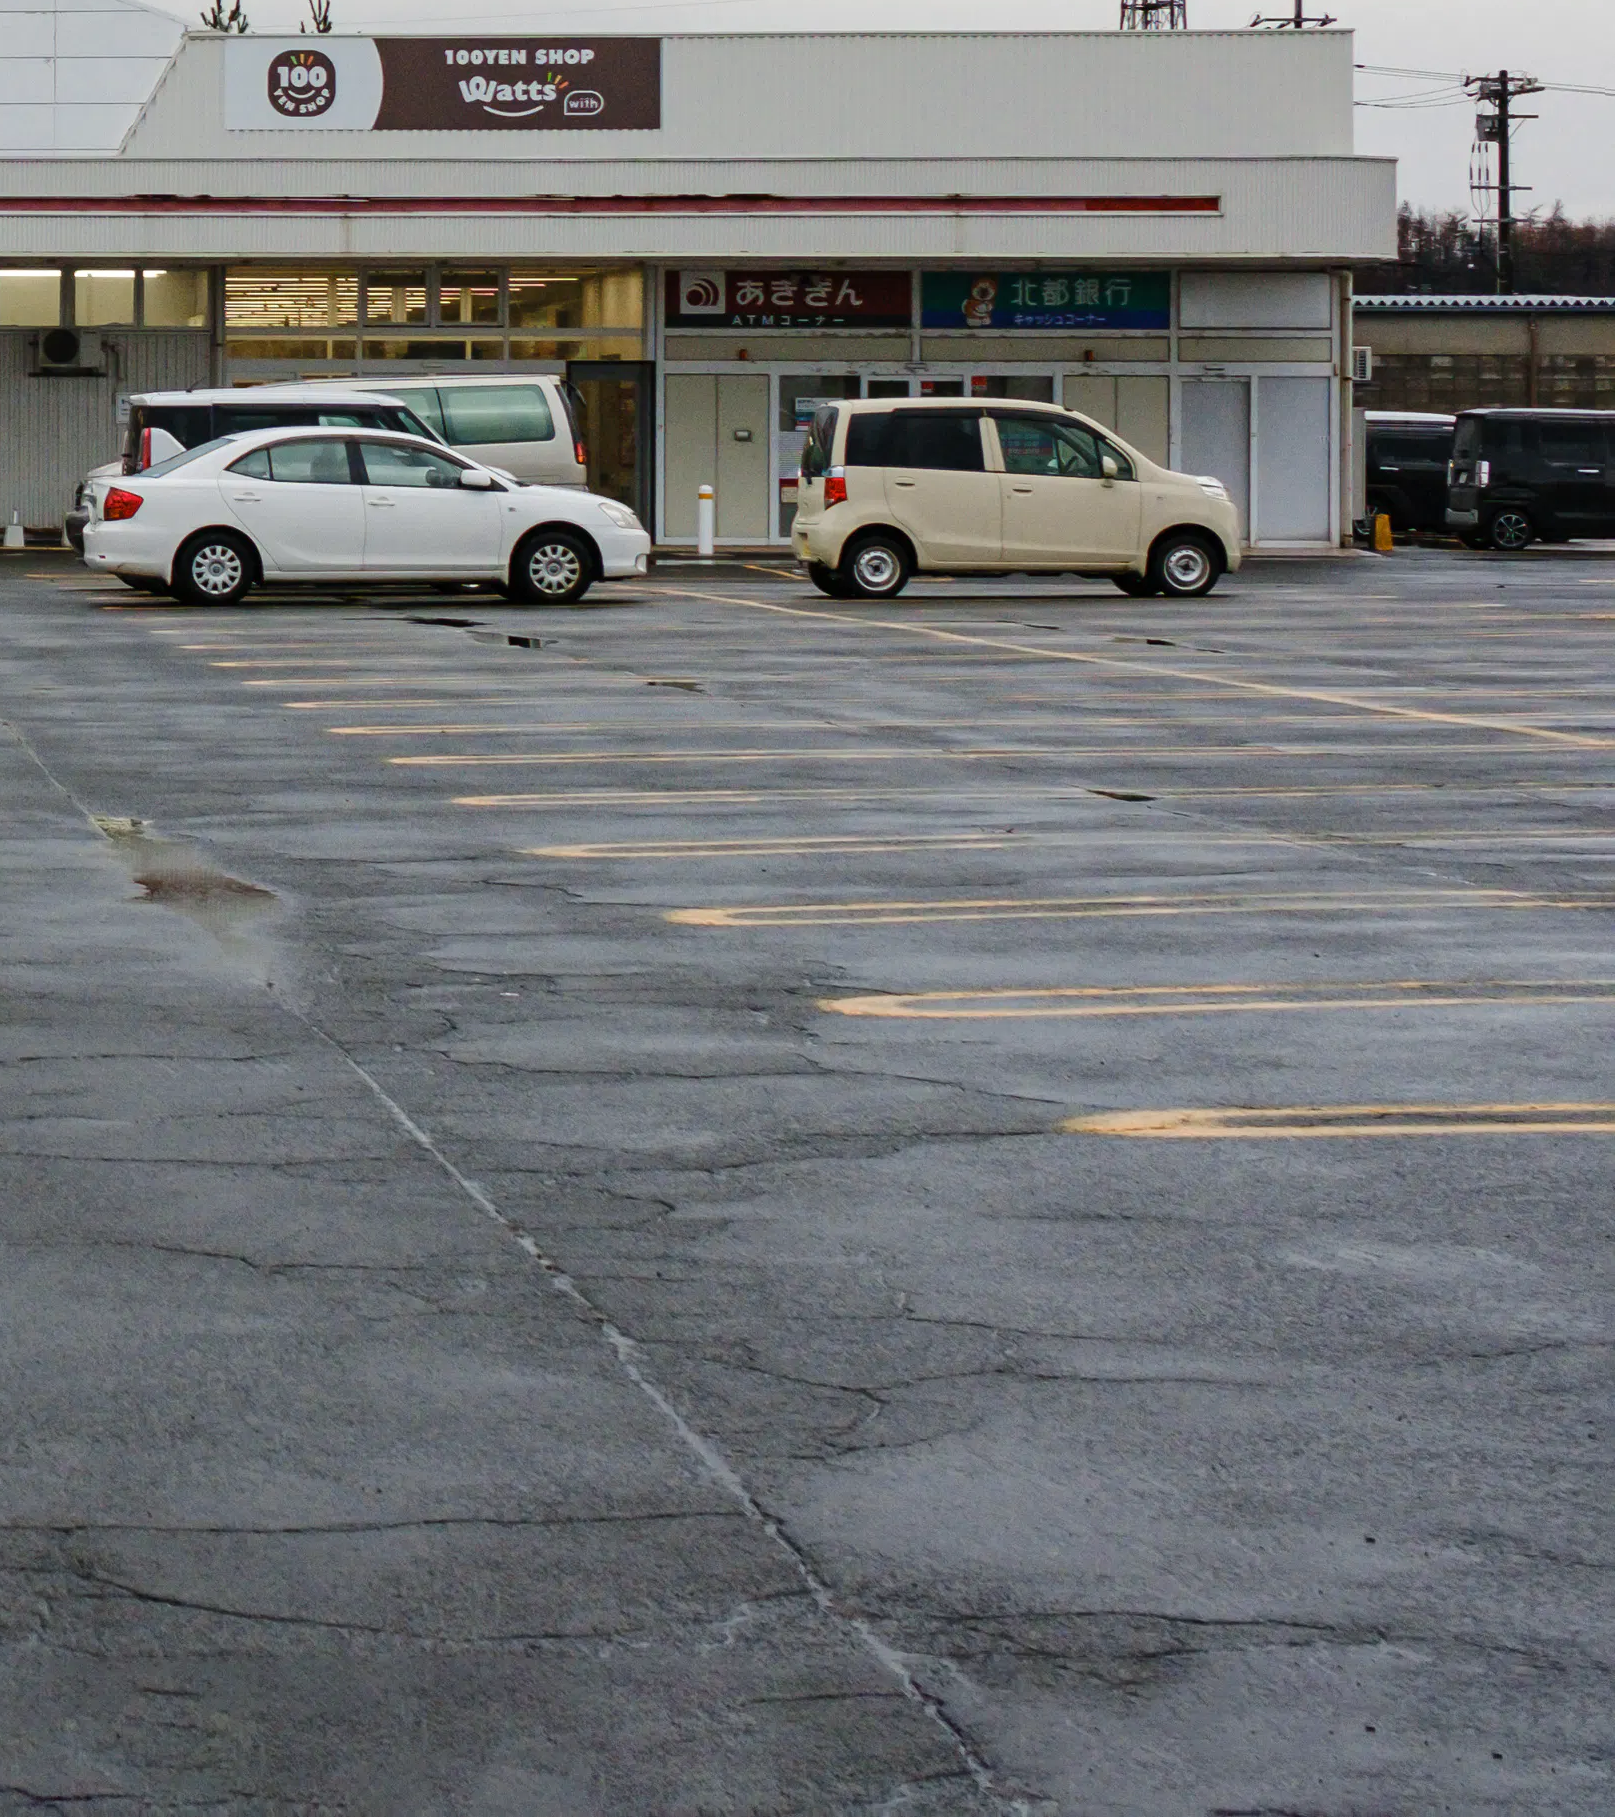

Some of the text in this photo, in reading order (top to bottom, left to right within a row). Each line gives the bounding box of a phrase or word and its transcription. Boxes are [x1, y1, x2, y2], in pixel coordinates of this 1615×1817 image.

[445, 49, 595, 65] 100YEN SHOP
[277, 65, 327, 87] 100
[273, 88, 330, 113] YEN SHOP
[458, 76, 557, 103] Watts
[569, 98, 599, 109] with
[736, 278, 863, 306] あきぎん
[1011, 278, 1132, 306] 北都銀行
